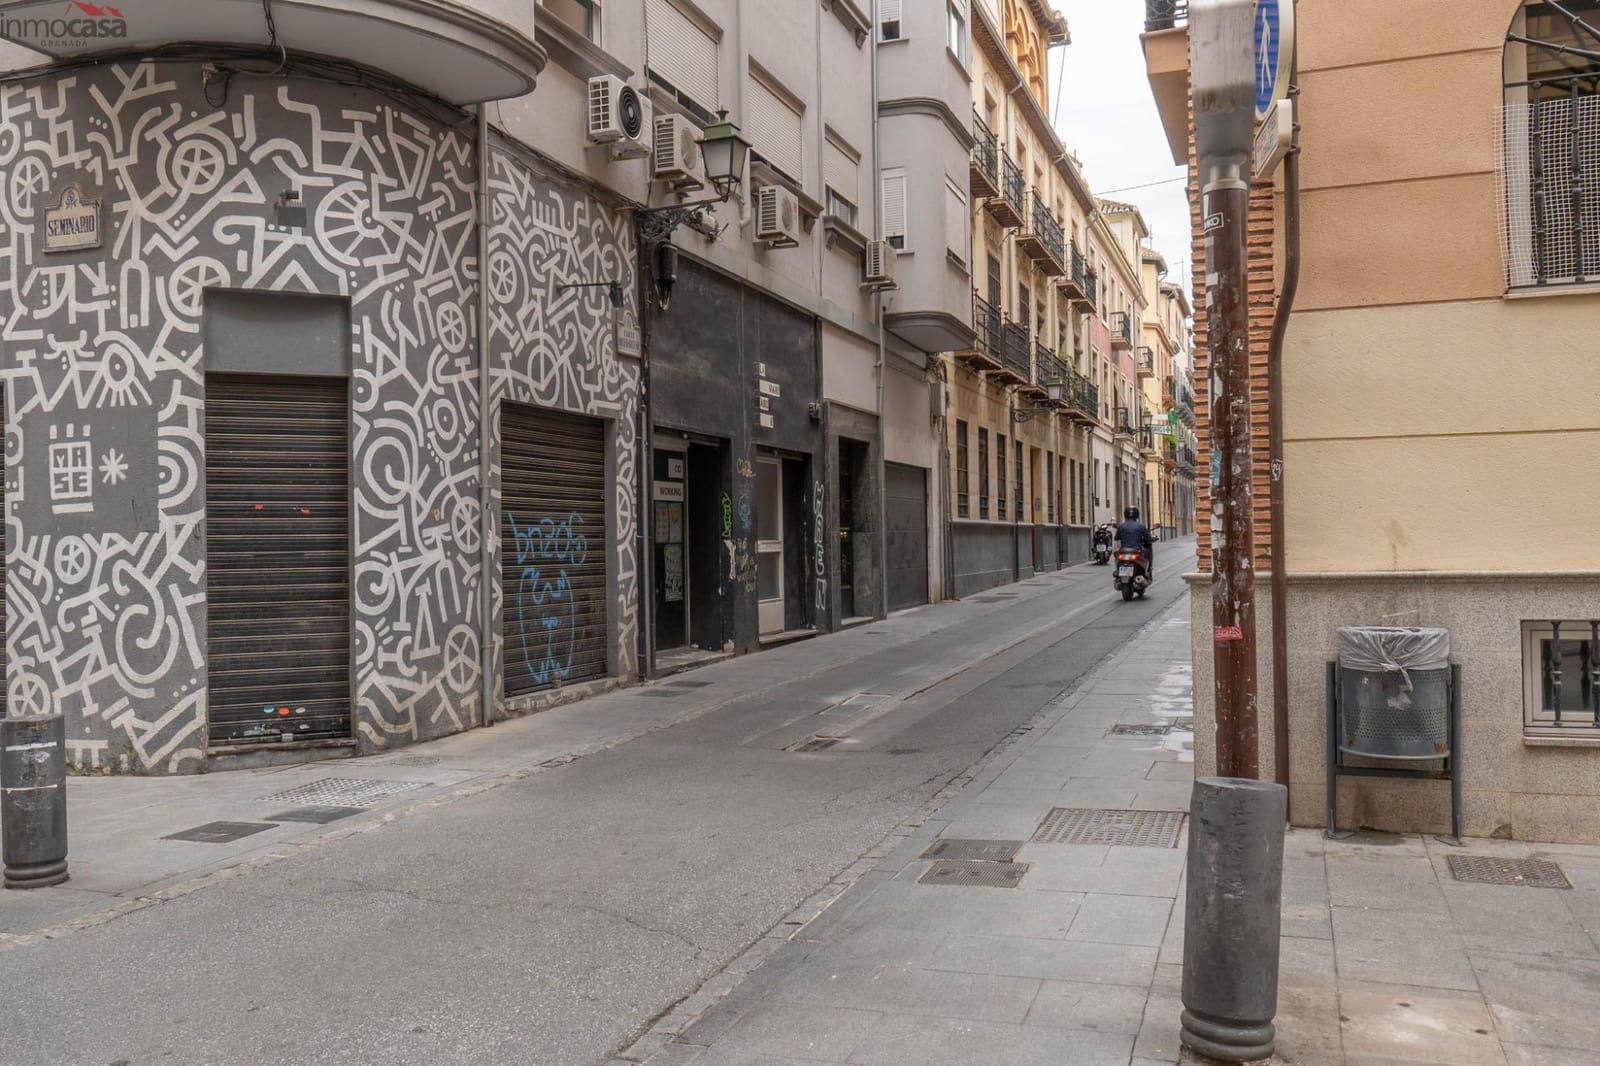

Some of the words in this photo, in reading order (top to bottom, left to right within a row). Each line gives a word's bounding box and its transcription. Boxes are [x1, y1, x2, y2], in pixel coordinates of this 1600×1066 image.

[48, 215, 95, 236] SEMINARIO
[674, 464, 682, 473] CO
[659, 487, 682, 497] WORKING
